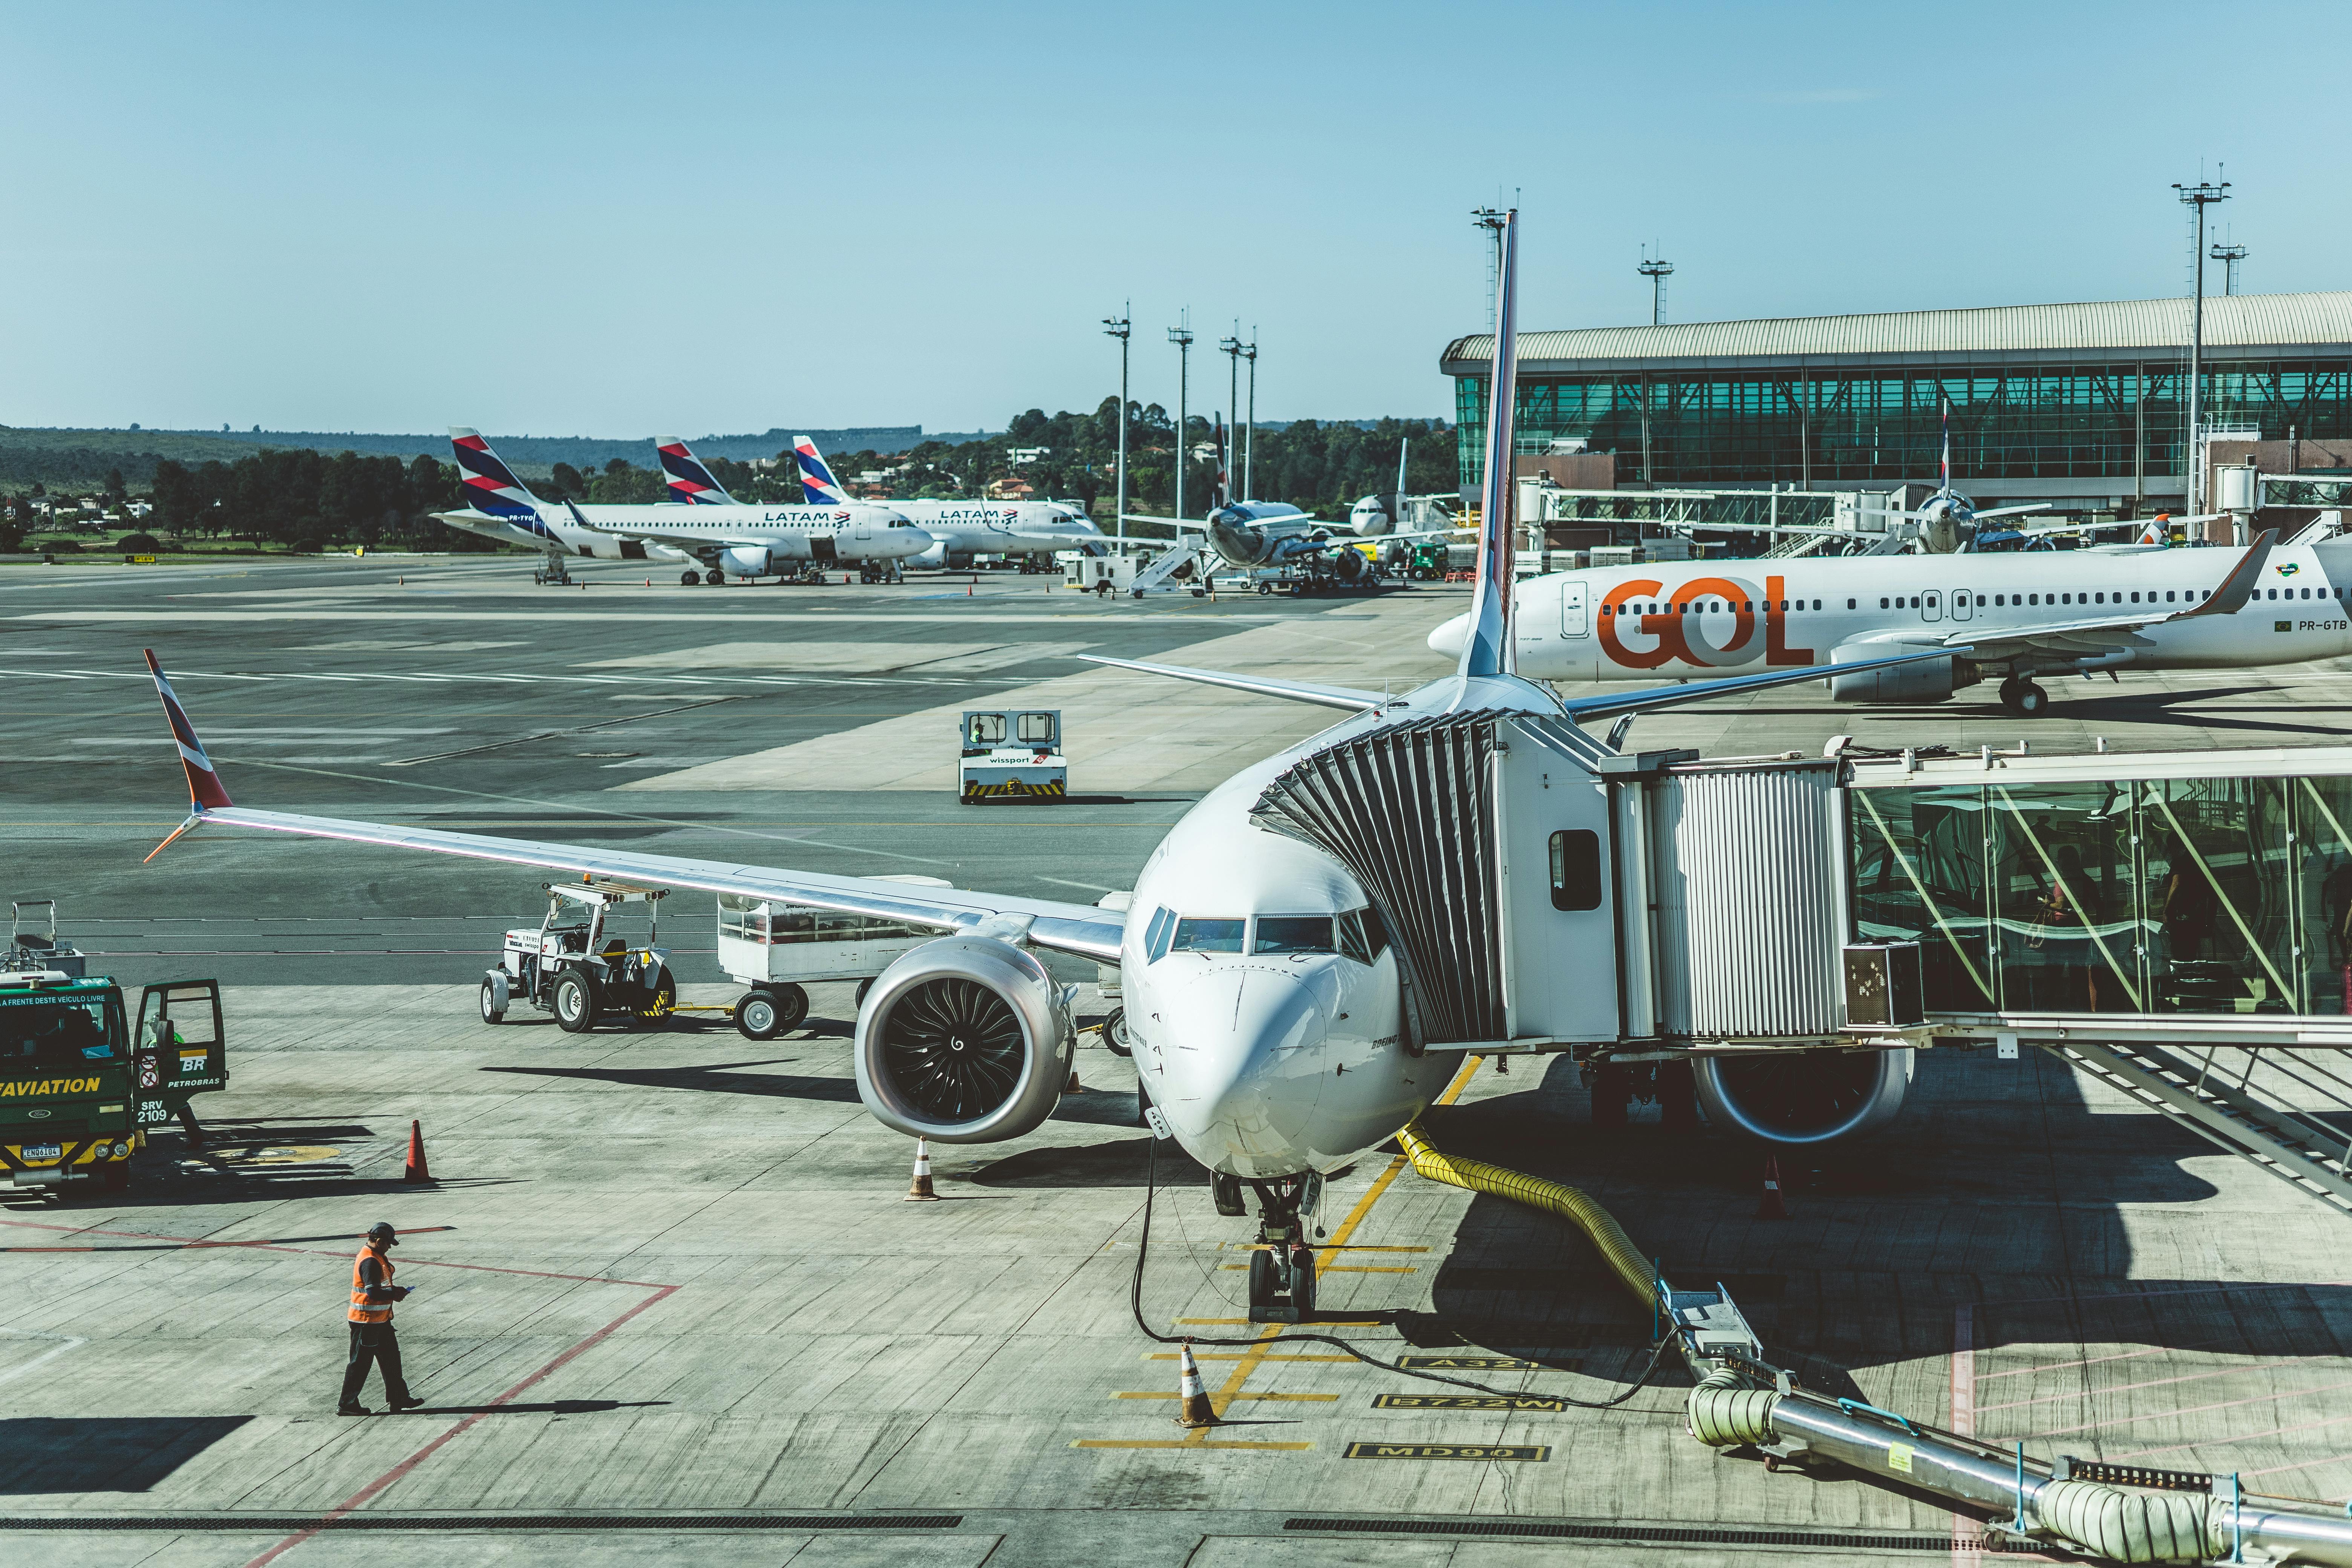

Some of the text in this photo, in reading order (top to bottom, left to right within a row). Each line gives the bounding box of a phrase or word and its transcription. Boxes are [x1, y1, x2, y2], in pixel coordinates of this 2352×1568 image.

[765, 513, 829, 521] LATAM
[2301, 535, 2314, 545] ATAM
[1597, 576, 1814, 669] GOL
[2299, 620, 2347, 631] PR-GTB
[1371, 1034, 1398, 1050] BOEING
[182, 1058, 205, 1071] BR
[168, 1078, 220, 1088] PETROBRAS
[141, 1100, 163, 1110] SRV
[138, 1109, 167, 1122] 2109
[1429, 1359, 1539, 1368] A321
[1391, 1398, 1556, 1408] B722W
[1377, 1447, 1514, 1457] MD90
